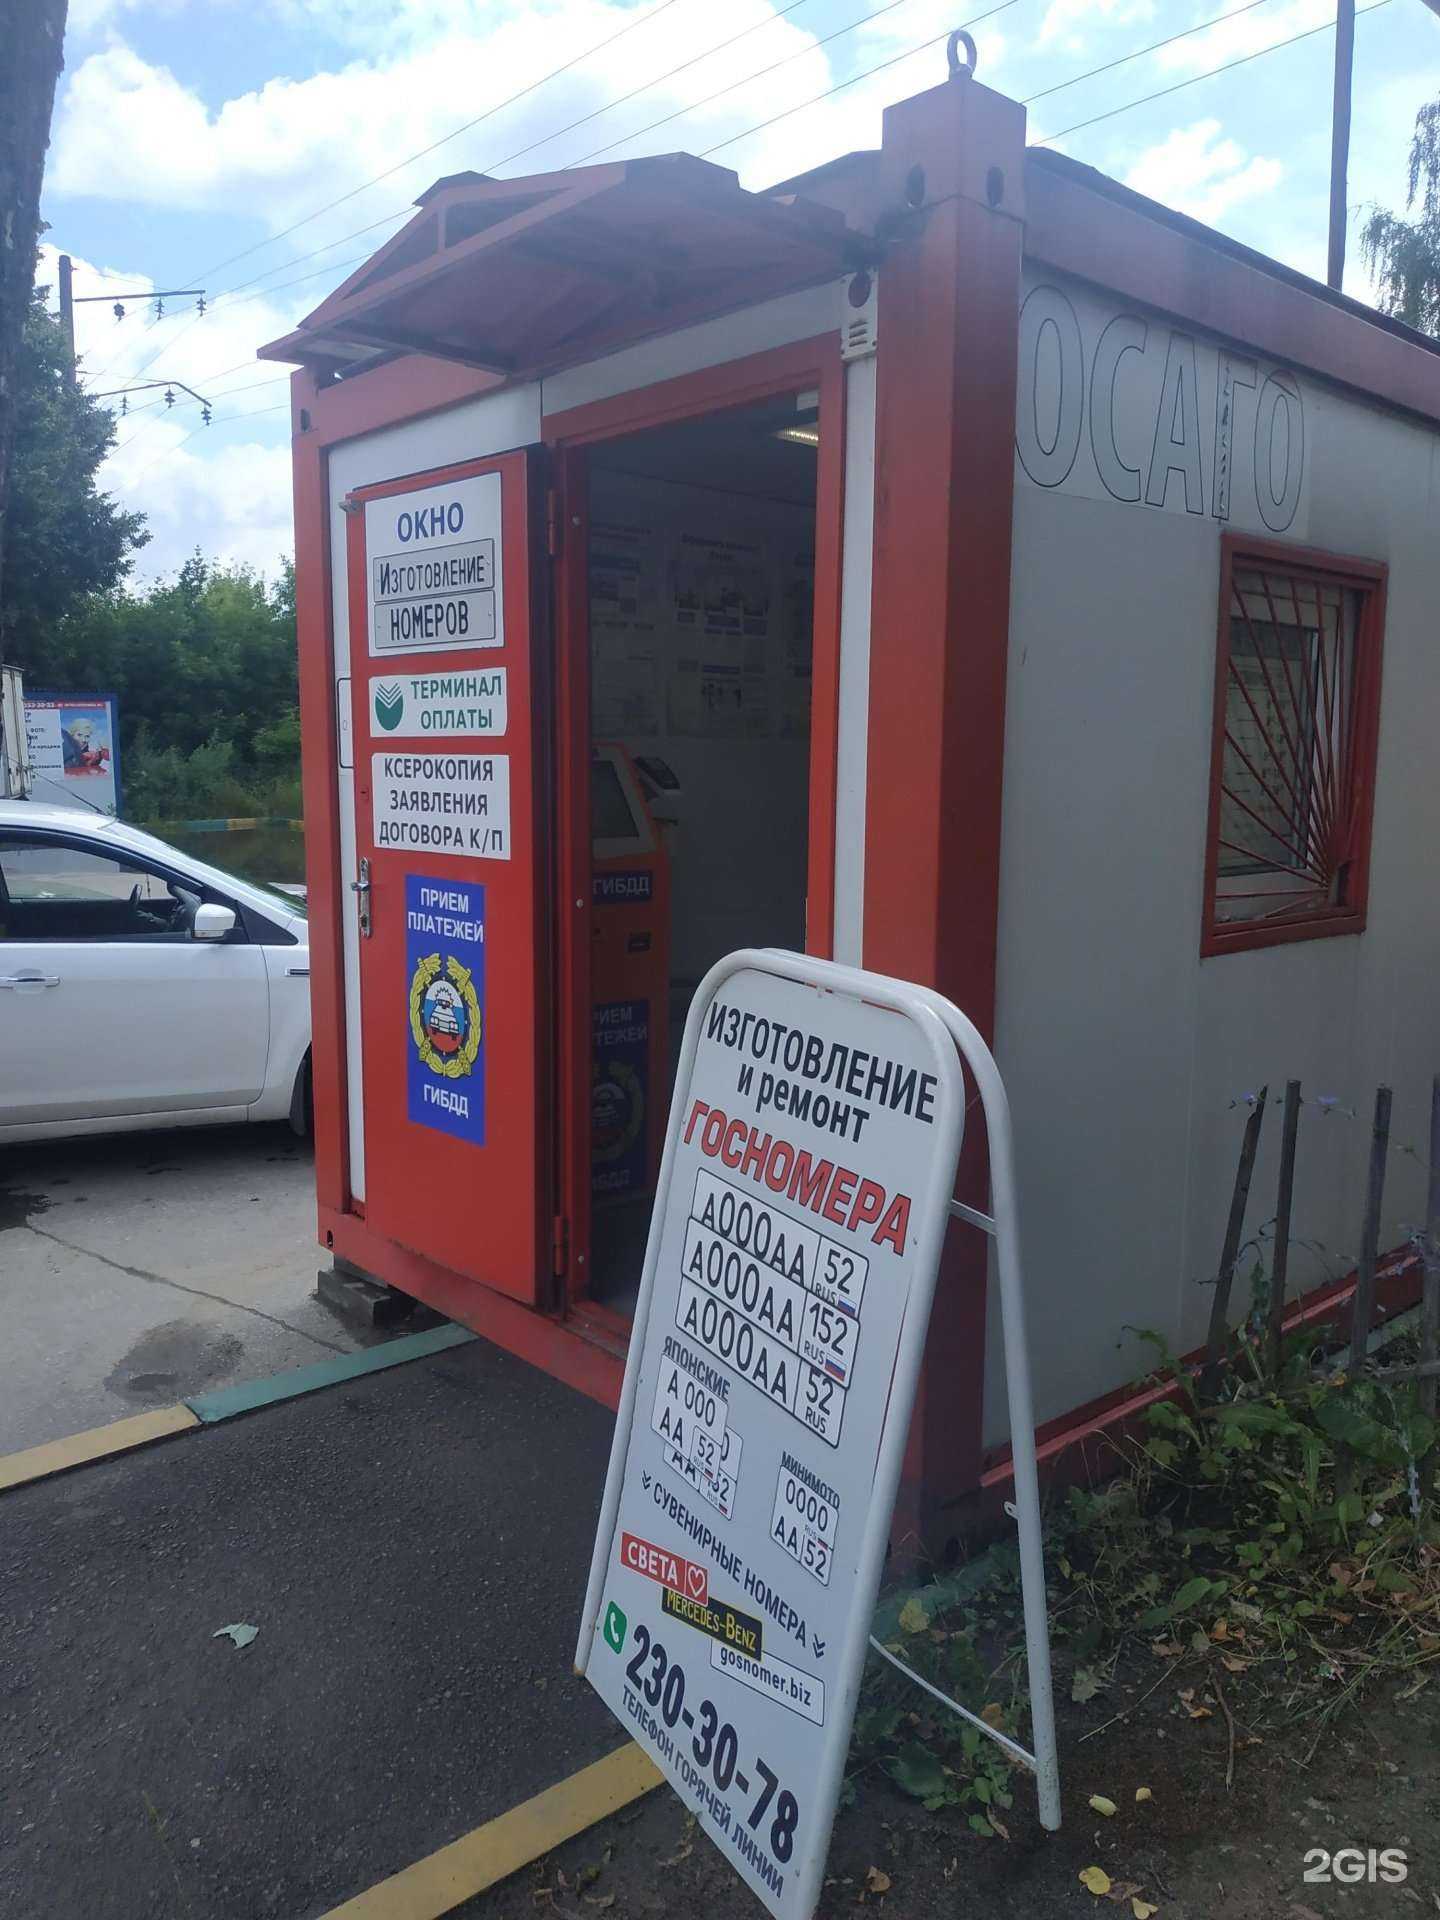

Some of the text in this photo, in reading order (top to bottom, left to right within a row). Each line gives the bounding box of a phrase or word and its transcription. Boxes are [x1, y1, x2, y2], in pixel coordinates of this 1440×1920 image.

[1015, 284, 1304, 532] ОСАГО
[398, 502, 464, 542] ОКНО
[391, 601, 469, 640] НОМЕРОВ
[411, 675, 502, 699] ТЕРМИНАЛ
[421, 709, 493, 729] ОПЛАТЫ
[384, 758, 493, 781] КСЕРОКОПИЯ
[390, 790, 488, 816] ЗАЯВЛЕНИЯ
[379, 821, 503, 853] ДОГОВОРА К/П
[420, 887, 469, 914] ПРИЕМ
[592, 876, 650, 896] ГИБДД
[407, 911, 484, 943] ПЛАТЕЖЕЙ
[592, 1006, 632, 1024] ИЕМ
[707, 1001, 938, 1124] ИЗГОТОВЛЕНИЕ
[423, 1083, 469, 1119] ГИБДД
[737, 1063, 870, 1143] и ремонт
[683, 1099, 912, 1257] ГОСНОМЕРА
[823, 1251, 855, 1295] 52
[814, 1282, 839, 1305] RUS
[808, 1302, 849, 1356] 152
[663, 1335, 731, 1398] ЯПОНСКИЕ
[803, 1340, 825, 1366] RUS
[805, 1366, 835, 1417] 52
[804, 1405, 827, 1435] RUS
[697, 1432, 715, 1467] 52
[627, 1541, 679, 1586] СВЕТА
[653, 1482, 806, 1649] СУВЕНИРНЫЕ НОМЕРА
[804, 1538, 827, 1578] 52
[667, 1590, 757, 1651] MERCEDES-BENZ
[720, 1647, 812, 1707] gosnomer.biz
[625, 1624, 799, 1865] 230-30-78
[623, 1684, 785, 1899] ТЕЛЕФОН ГОРЯЧЕЙ ЛИНИИ
